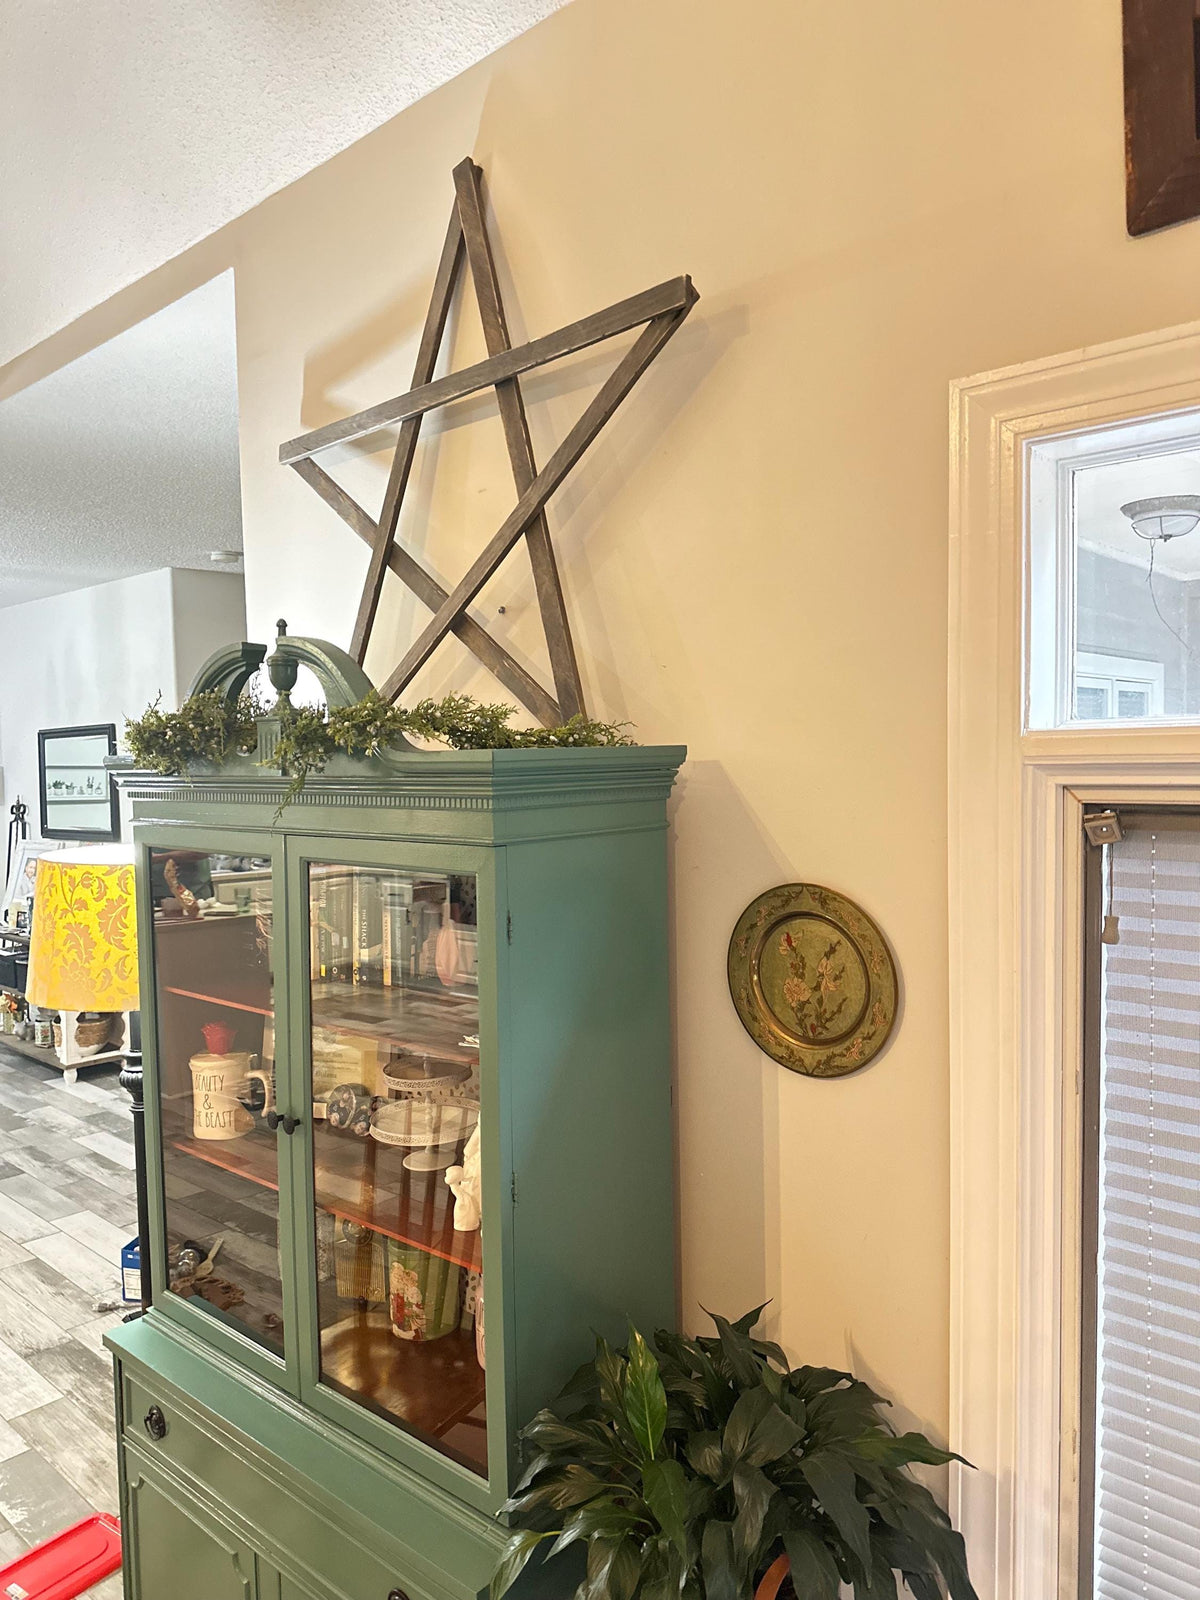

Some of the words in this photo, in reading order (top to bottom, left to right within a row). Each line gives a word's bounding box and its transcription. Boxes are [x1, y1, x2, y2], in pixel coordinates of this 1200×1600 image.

[195, 1074, 225, 1092] BEAUTY
[203, 1094, 214, 1110] &
[205, 1110, 233, 1128] BEAST
